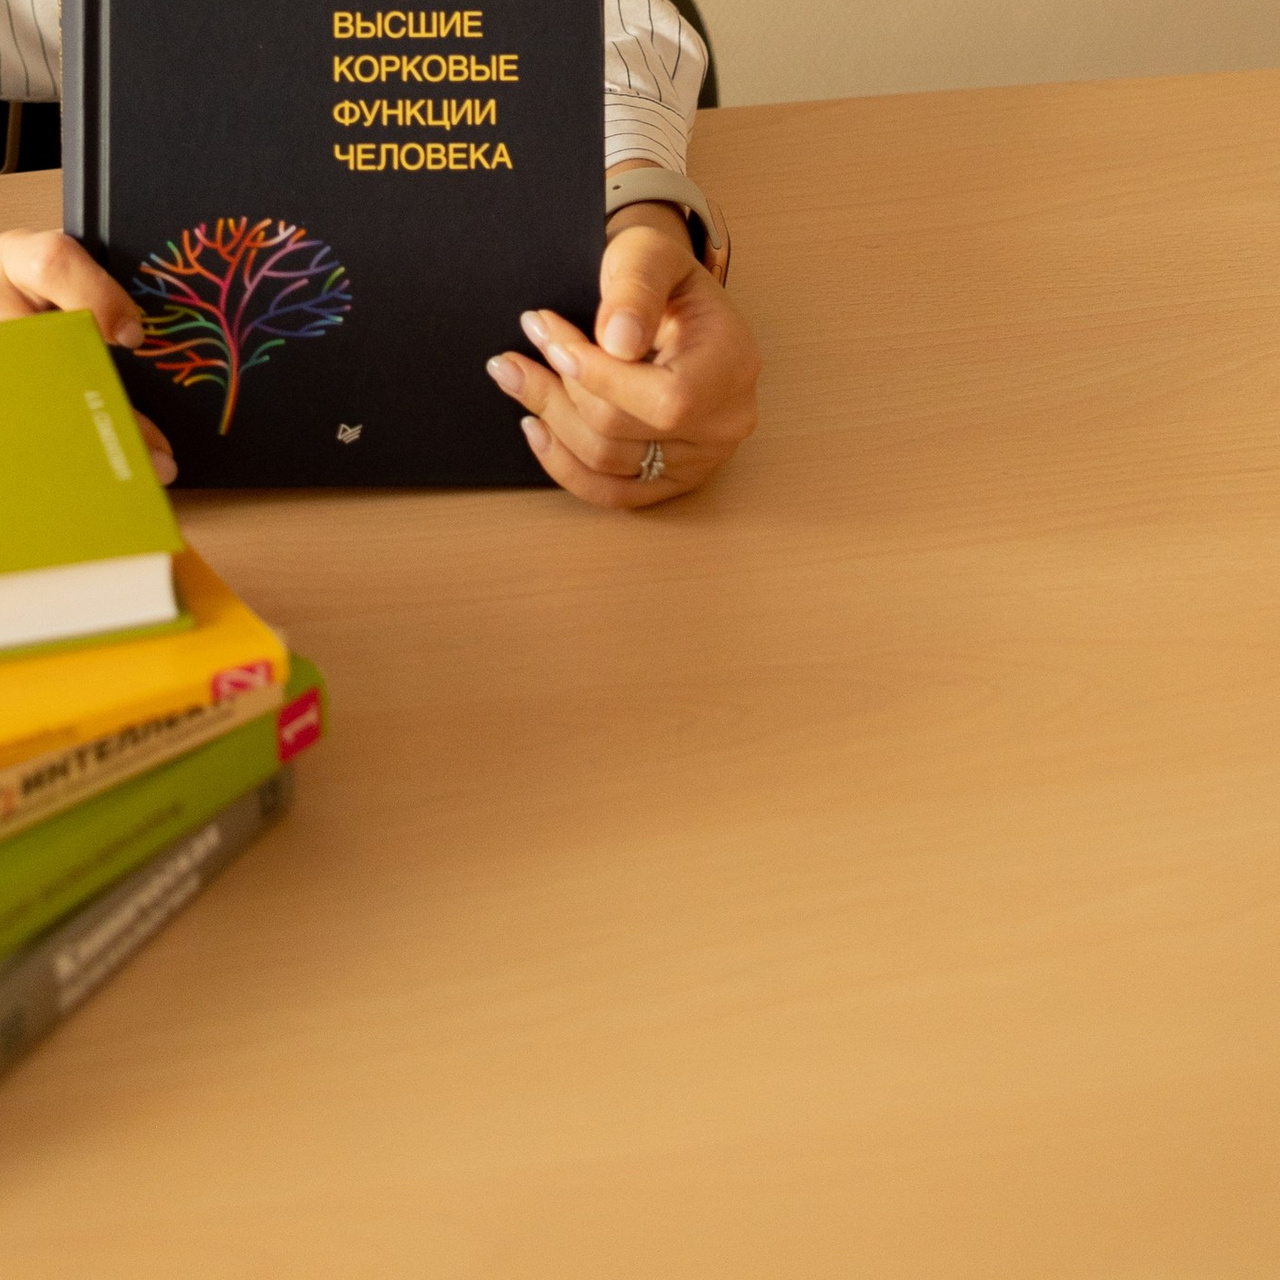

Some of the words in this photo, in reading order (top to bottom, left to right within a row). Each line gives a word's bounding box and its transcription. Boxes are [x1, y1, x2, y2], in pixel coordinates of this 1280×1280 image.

[332, 11, 484, 38] ВЫСШИЕ
[332, 54, 520, 83] КОРКОВЫЕ
[332, 99, 497, 130] ФУНКЦИИ
[333, 143, 514, 171] ЧЕЛОВЕКА
